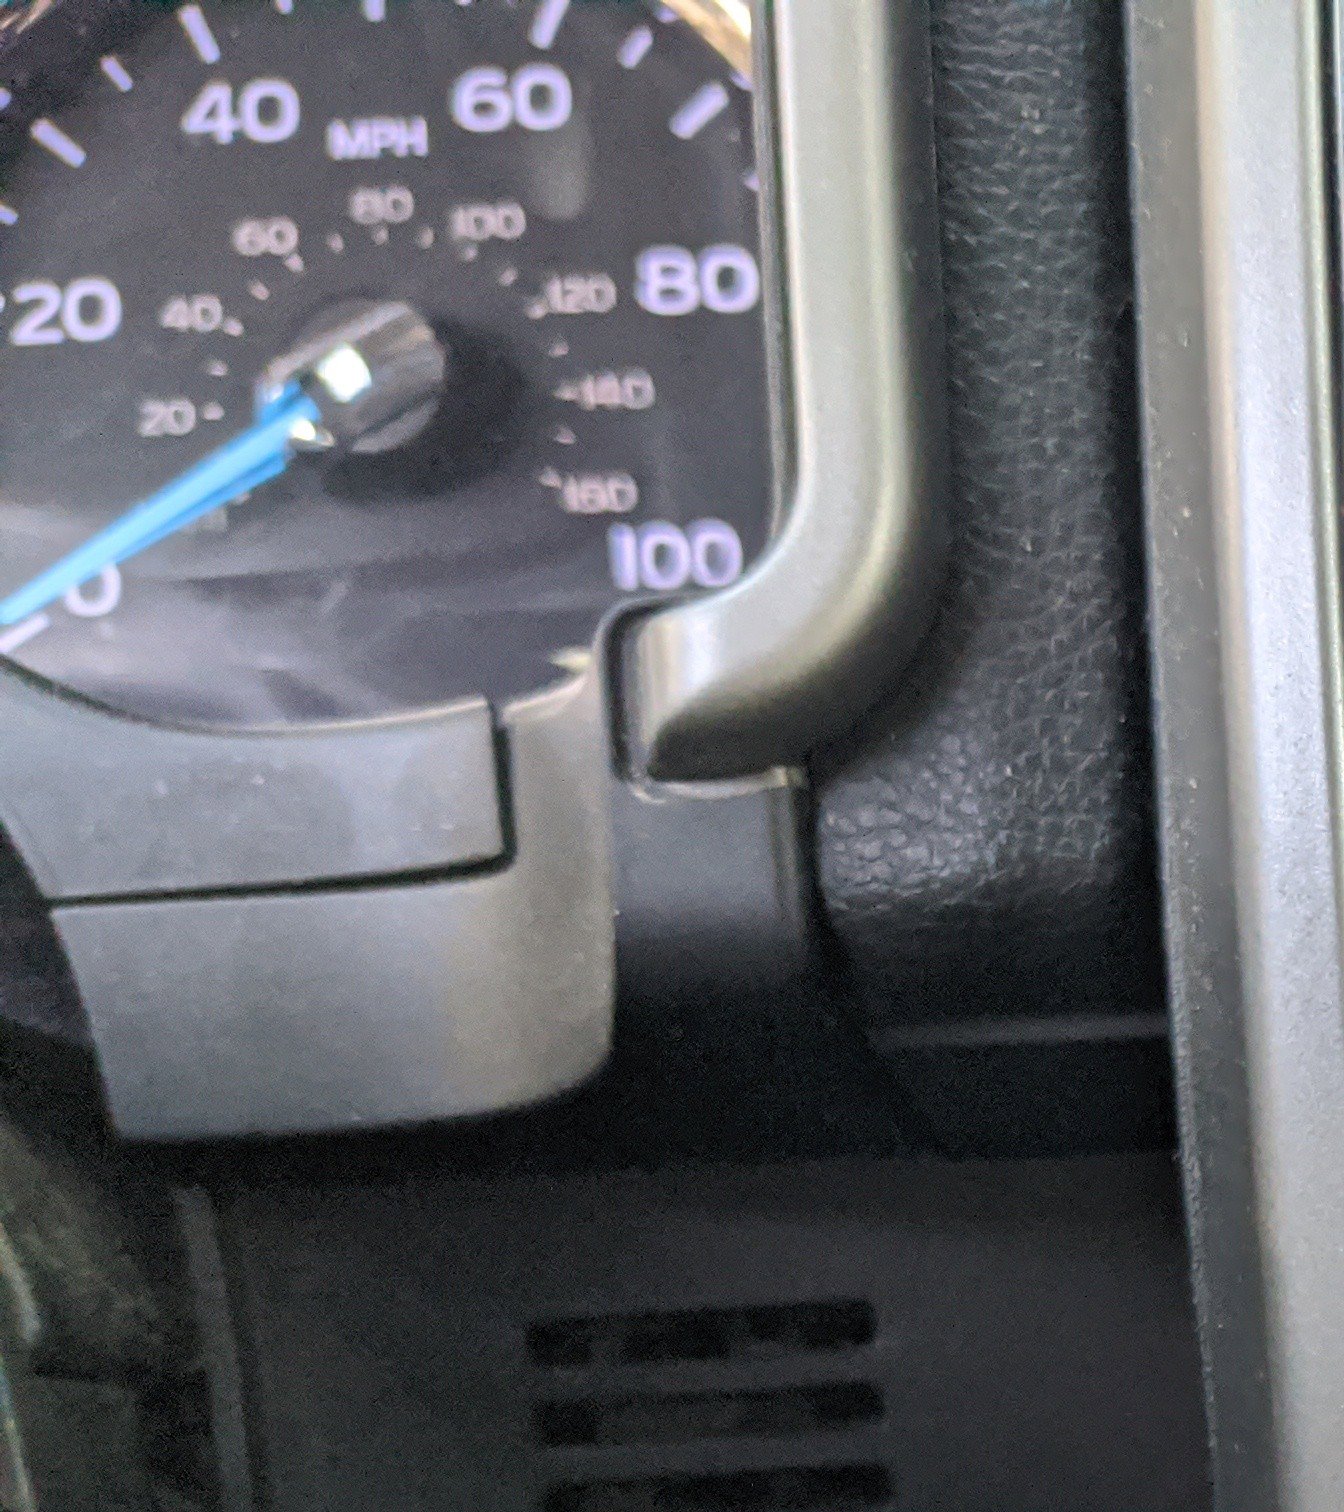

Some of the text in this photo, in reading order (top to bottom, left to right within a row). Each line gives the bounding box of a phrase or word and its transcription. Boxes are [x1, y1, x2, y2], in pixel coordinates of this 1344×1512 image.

[182, 78, 301, 144] 40
[451, 62, 572, 132] 60
[327, 116, 428, 160] MPH
[350, 186, 414, 225] 80
[450, 203, 527, 241] 100
[232, 216, 299, 257] 60
[545, 272, 618, 314] 120
[634, 244, 760, 315] 80
[12, 278, 123, 346] 20
[160, 295, 223, 333] 40
[139, 398, 197, 437] 20
[608, 518, 743, 592] 100
